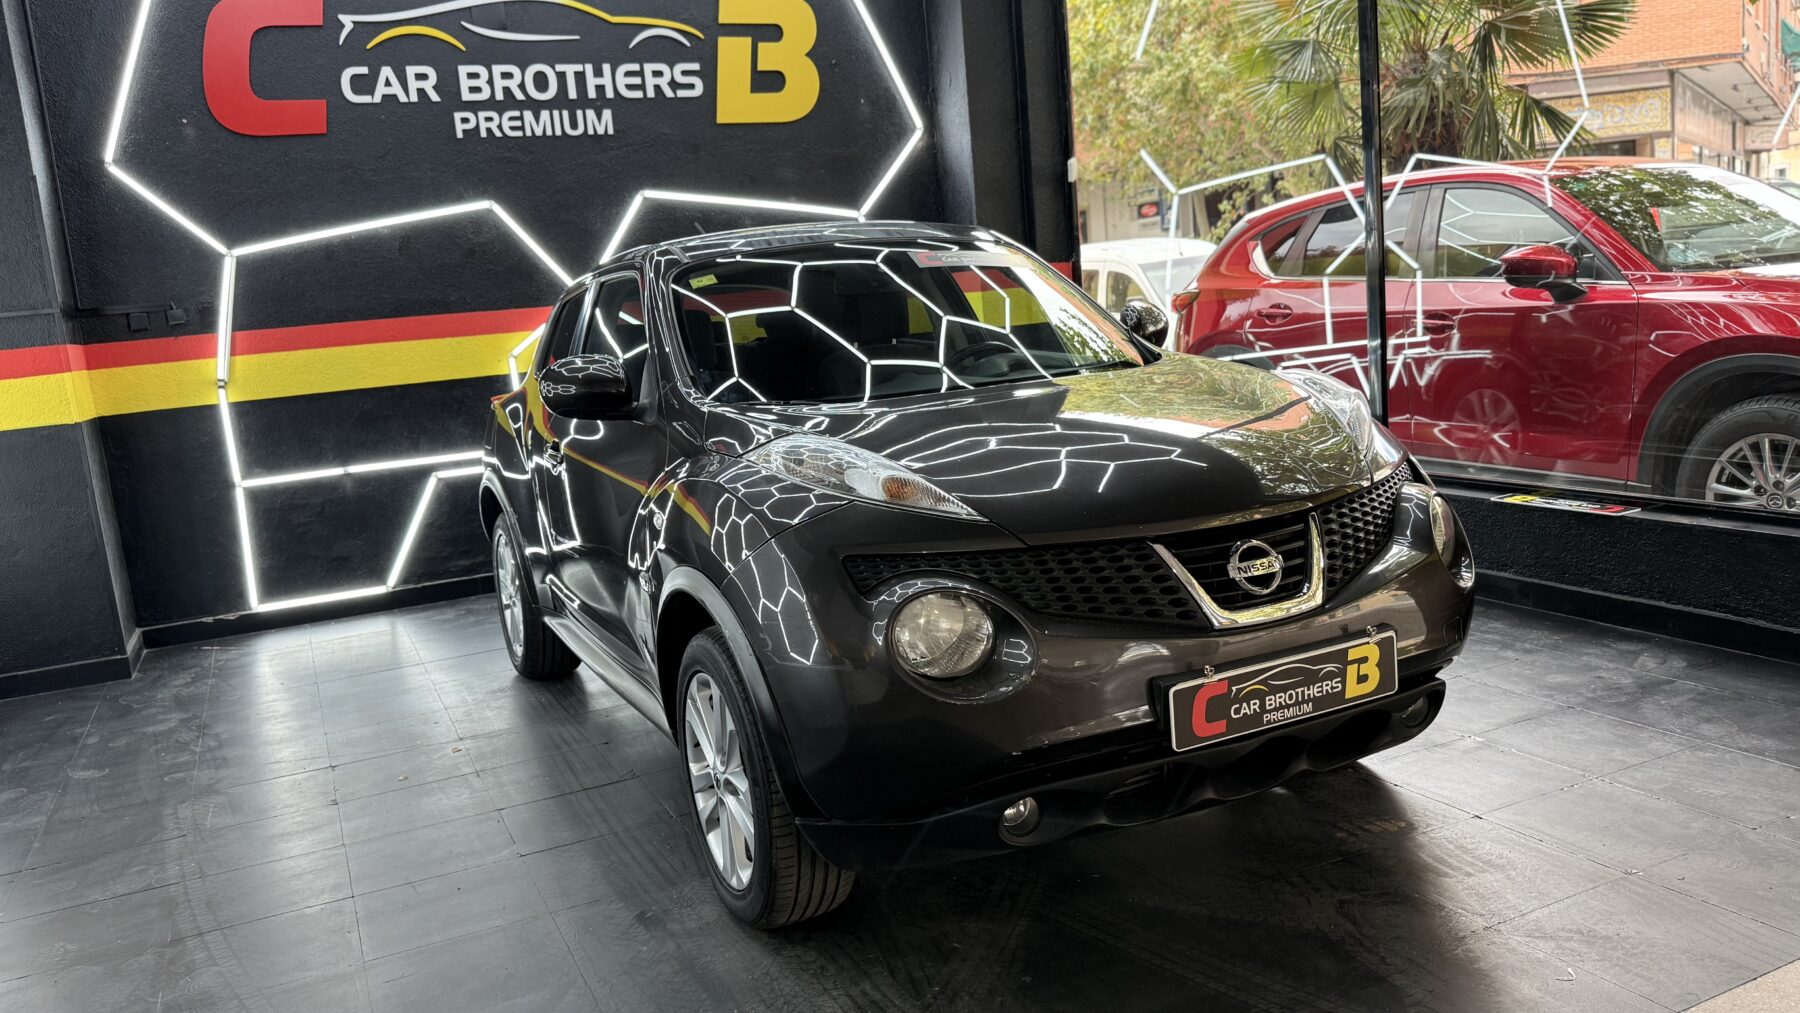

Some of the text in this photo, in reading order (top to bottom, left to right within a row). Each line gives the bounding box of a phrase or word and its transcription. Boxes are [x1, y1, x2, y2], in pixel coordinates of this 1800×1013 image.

[340, 62, 704, 104] CAR BROTHERS
[453, 109, 614, 138] PREMIUM
[1230, 677, 1342, 719] CAR BROTHERS
[1263, 702, 1313, 724] PREMIUM
